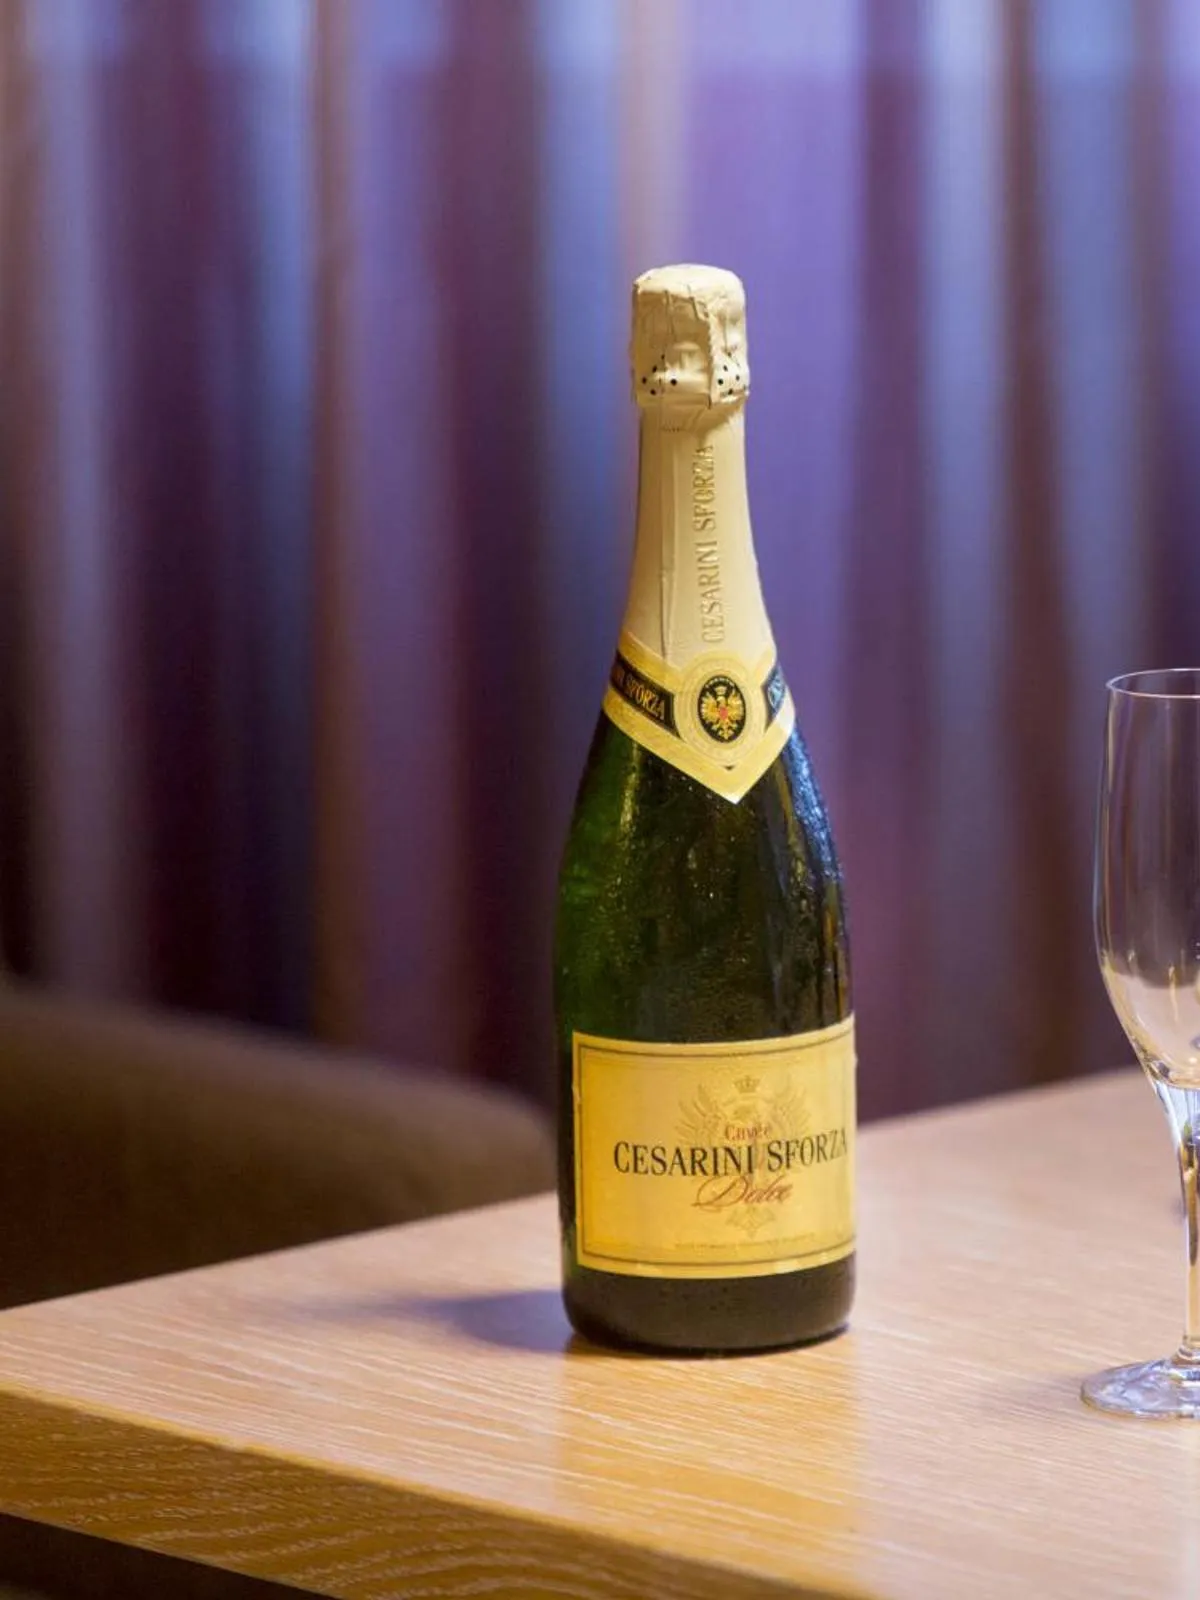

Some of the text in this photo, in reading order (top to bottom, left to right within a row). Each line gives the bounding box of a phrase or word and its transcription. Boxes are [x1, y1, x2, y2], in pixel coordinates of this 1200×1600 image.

[692, 444, 725, 644] CESARINI SFORZA
[612, 1126, 849, 1177] CESARINI SFORZA
